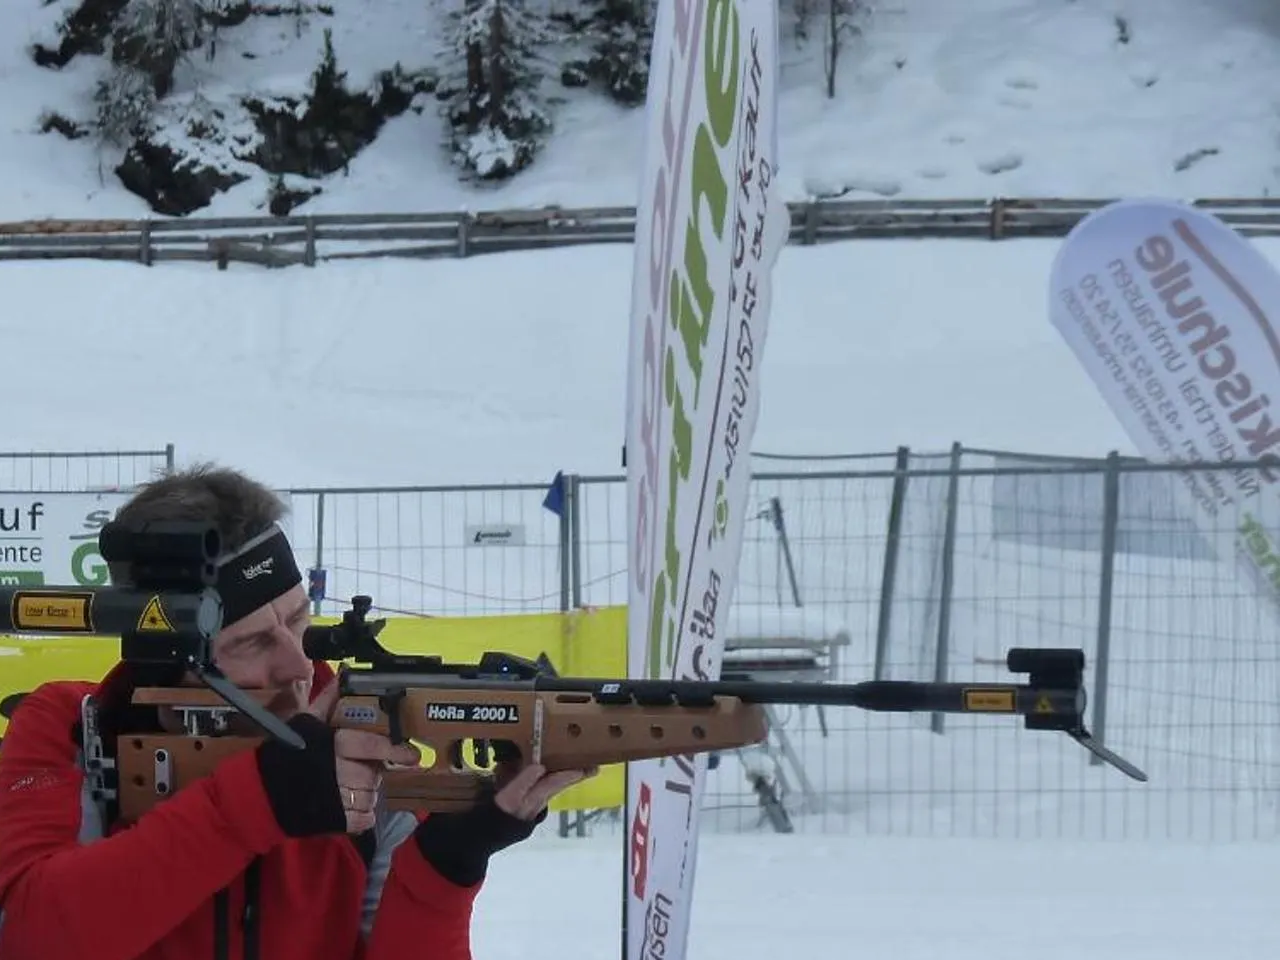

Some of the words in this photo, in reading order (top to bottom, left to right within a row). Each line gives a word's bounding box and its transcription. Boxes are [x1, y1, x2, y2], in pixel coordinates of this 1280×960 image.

[428, 705, 465, 720] HoRa
[472, 706, 506, 721] 2000
[508, 707, 518, 721] L
